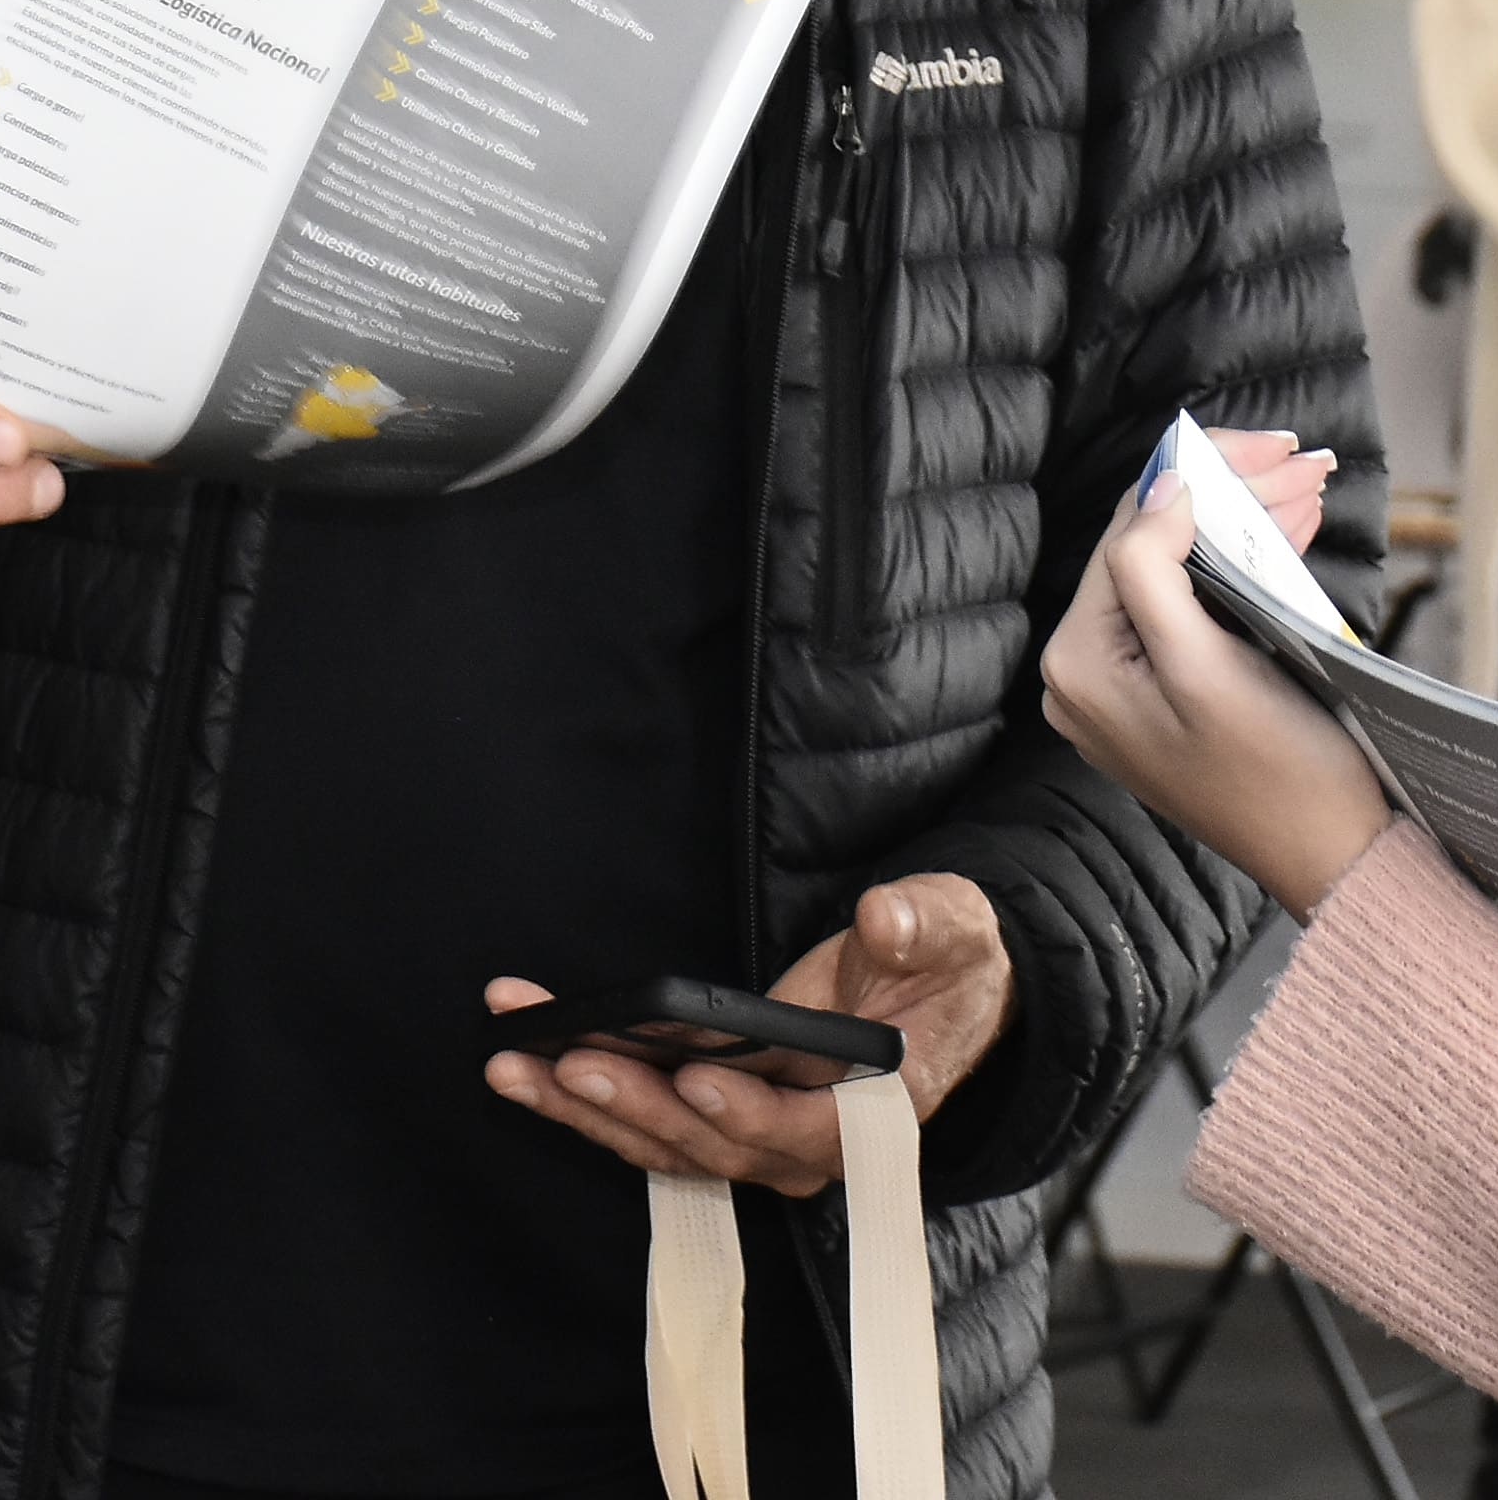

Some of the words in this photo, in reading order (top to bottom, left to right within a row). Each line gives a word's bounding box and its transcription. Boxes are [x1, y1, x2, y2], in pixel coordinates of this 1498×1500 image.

[240, 27, 331, 85] Nacional
[441, 10, 479, 35] Furgón
[477, 27, 530, 61] Paquetero
[528, 20, 558, 41] Sider
[598, 6, 627, 27] Semi
[623, 19, 655, 42] Playo
[413, 68, 454, 95] Camión
[452, 87, 488, 112] Chasis
[493, 107, 541, 138] Balancín
[426, 38, 503, 83] Semirremolque
[500, 75, 546, 105] Baranda
[544, 97, 589, 127] Volcable
[399, 96, 451, 129] Utilitarios
[449, 121, 486, 146] Chicos
[491, 142, 537, 172] Grandes
[299, 220, 380, 267] Nuestras
[378, 258, 427, 288] rutas
[426, 276, 523, 323] habituales
